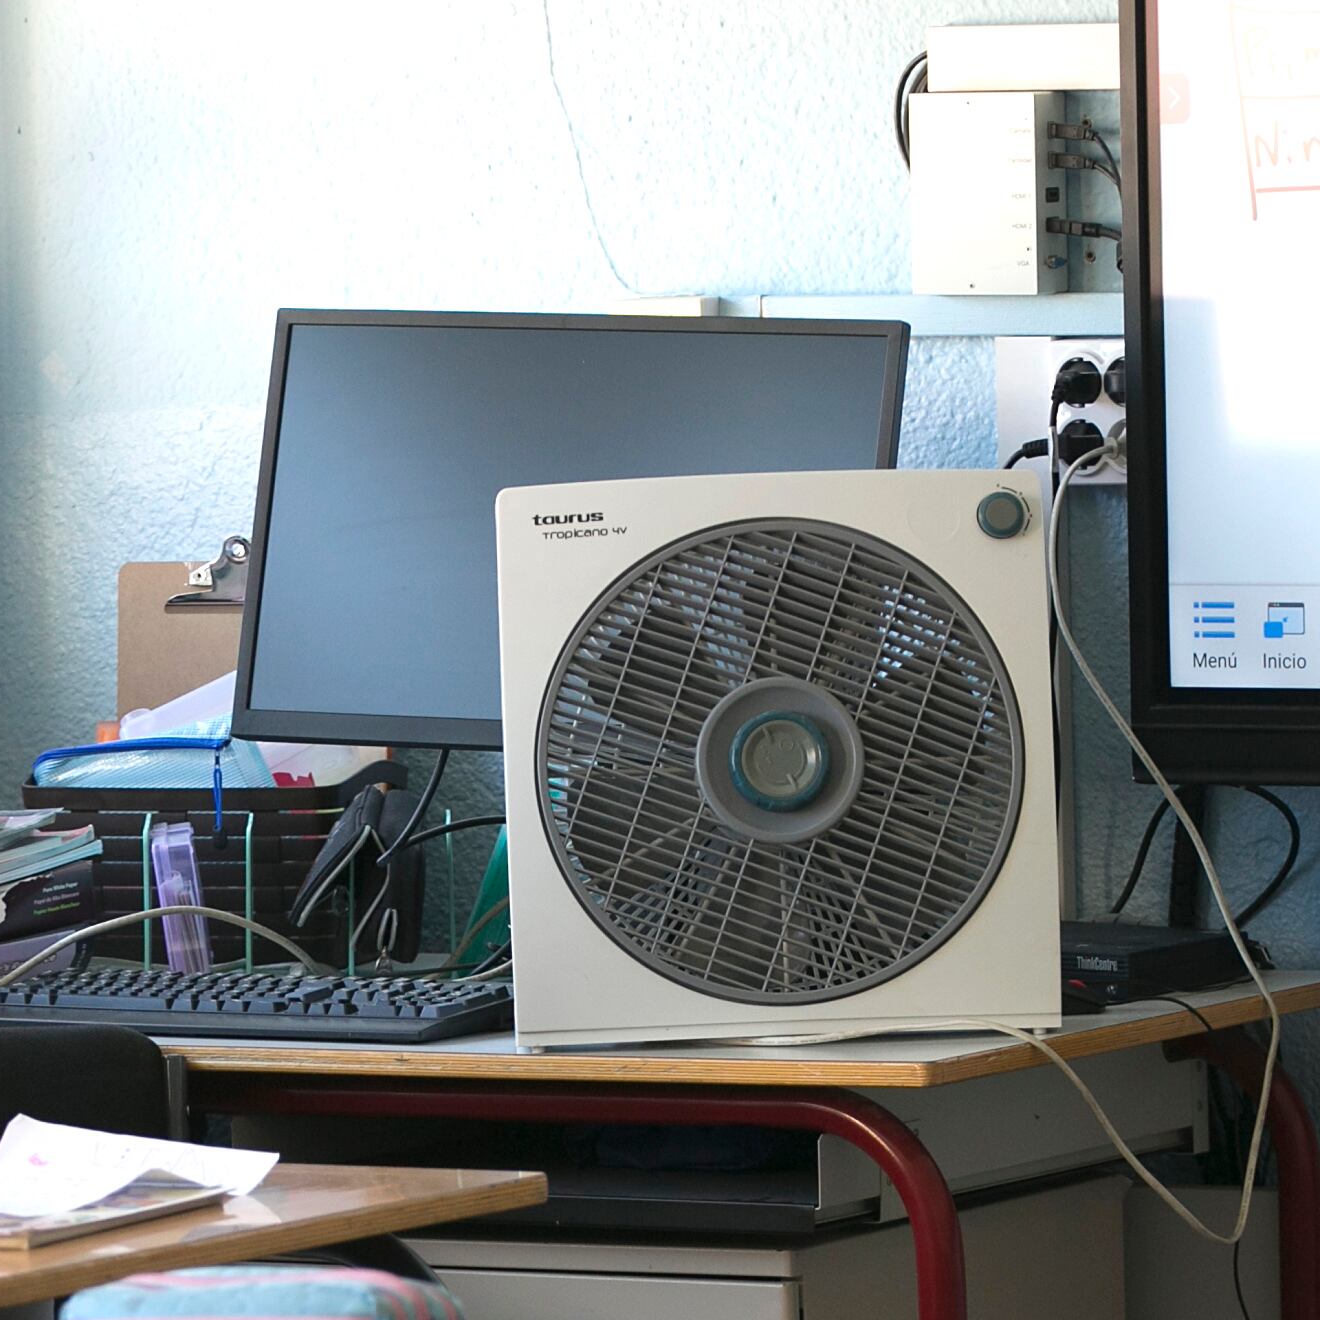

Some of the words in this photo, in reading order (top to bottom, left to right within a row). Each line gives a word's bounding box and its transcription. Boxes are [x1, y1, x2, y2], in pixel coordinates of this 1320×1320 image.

[532, 512, 604, 526] taurus
[1192, 651, 1237, 669] Menú
[1263, 653, 1307, 670] Inicio
[1076, 955, 1118, 972] ThinkCentre
